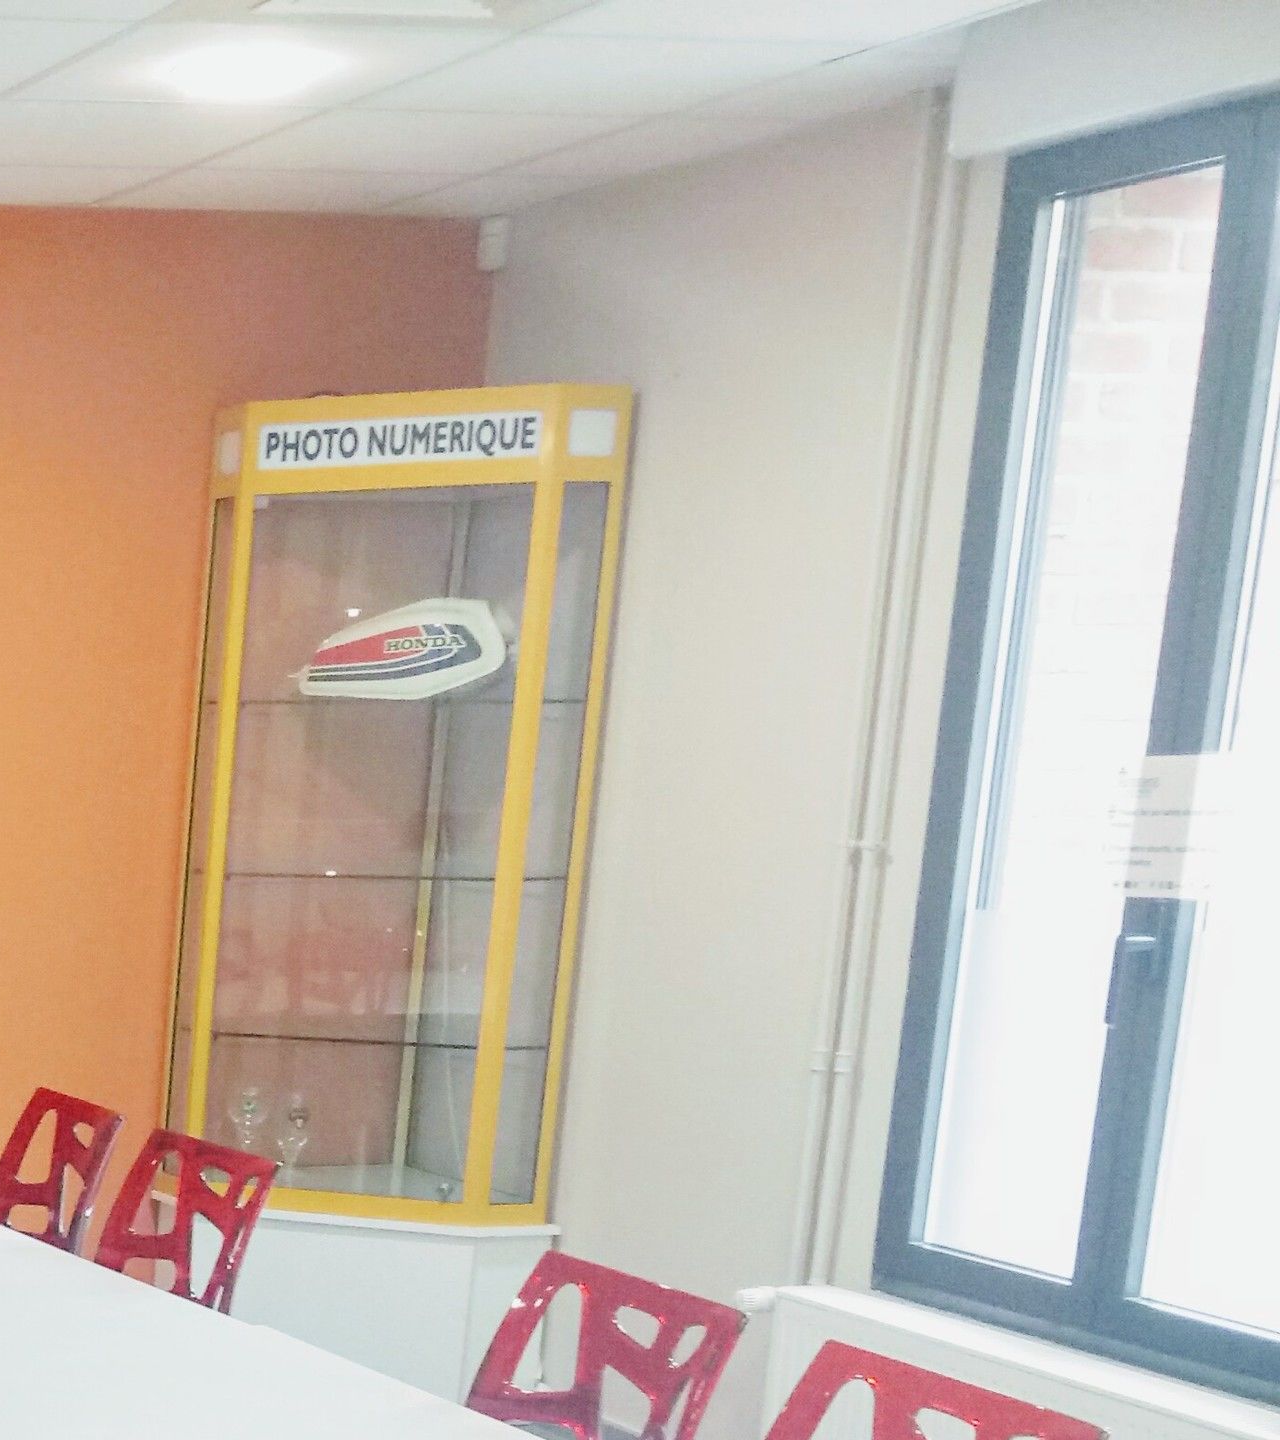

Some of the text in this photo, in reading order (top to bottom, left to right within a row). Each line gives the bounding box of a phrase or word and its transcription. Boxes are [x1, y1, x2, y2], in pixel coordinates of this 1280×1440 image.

[265, 416, 538, 462] PHOTO NUMERIQUE
[385, 635, 464, 653] HONDA
